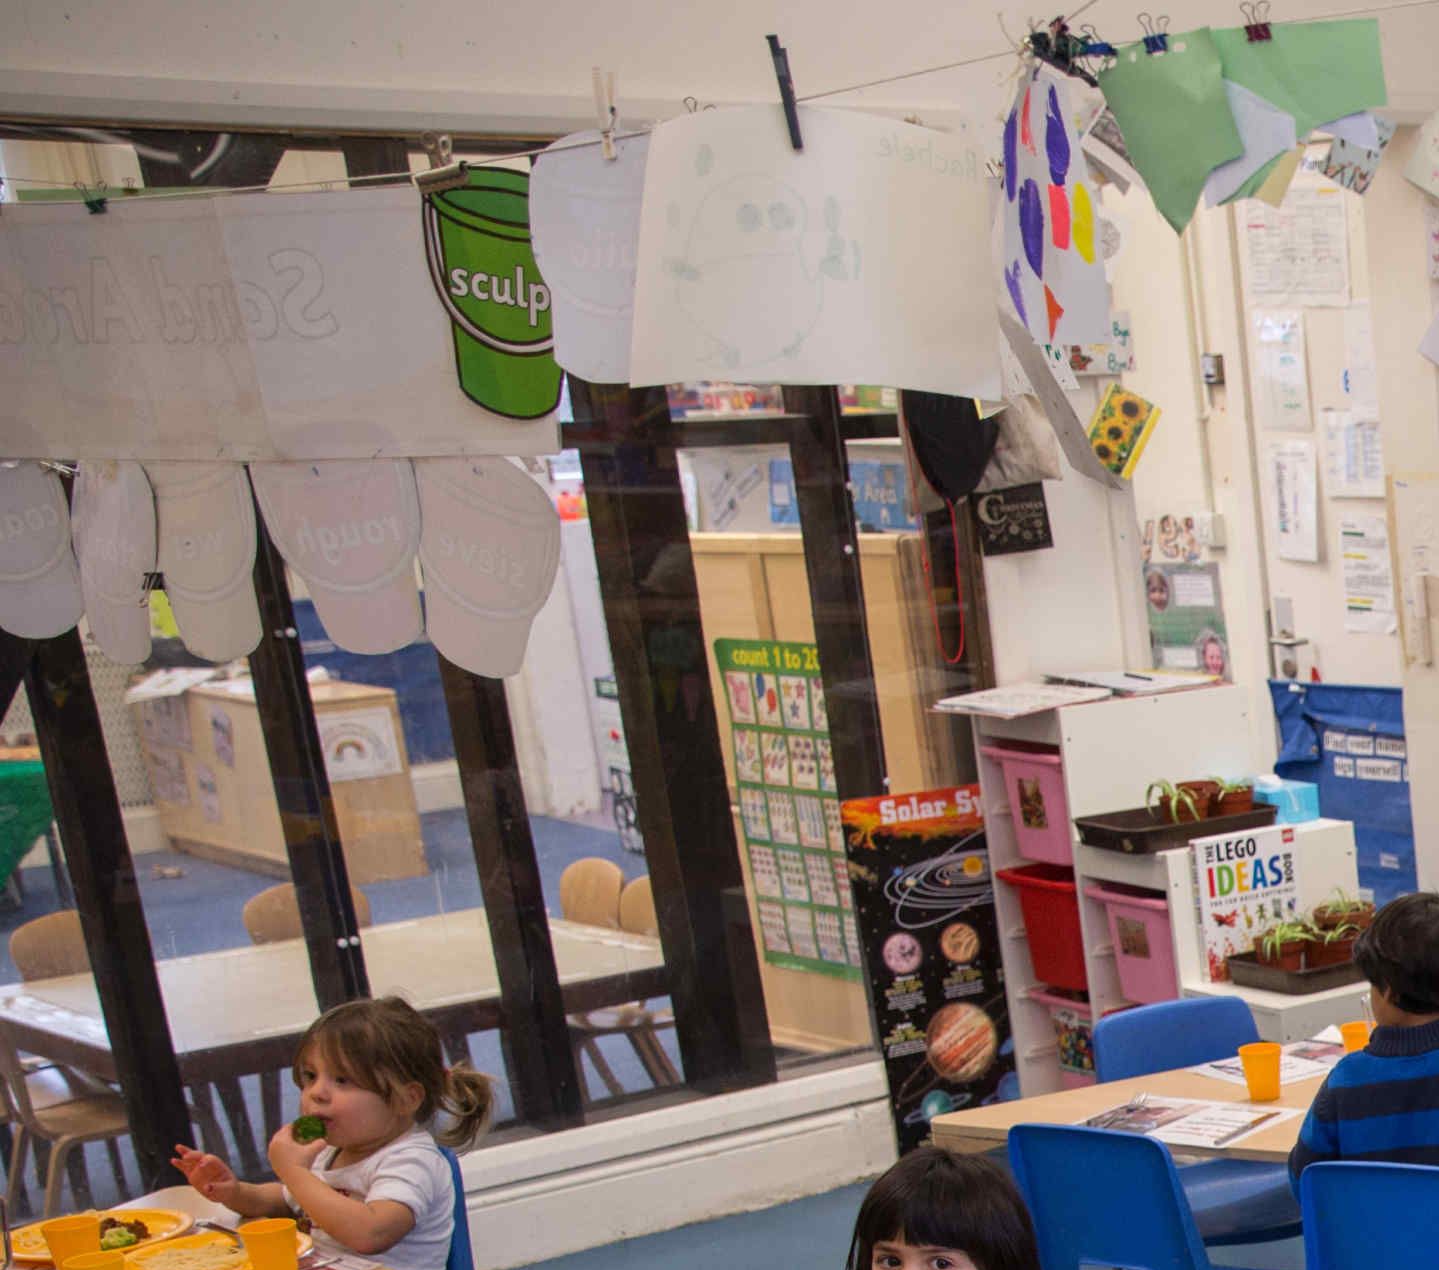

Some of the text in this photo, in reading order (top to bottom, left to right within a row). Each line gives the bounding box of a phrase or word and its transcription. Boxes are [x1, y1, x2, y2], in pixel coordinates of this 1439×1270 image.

[879, 796, 947, 828] Solar
[1215, 837, 1257, 862] LEGO
[1207, 852, 1294, 899] IDEAS BOOK
